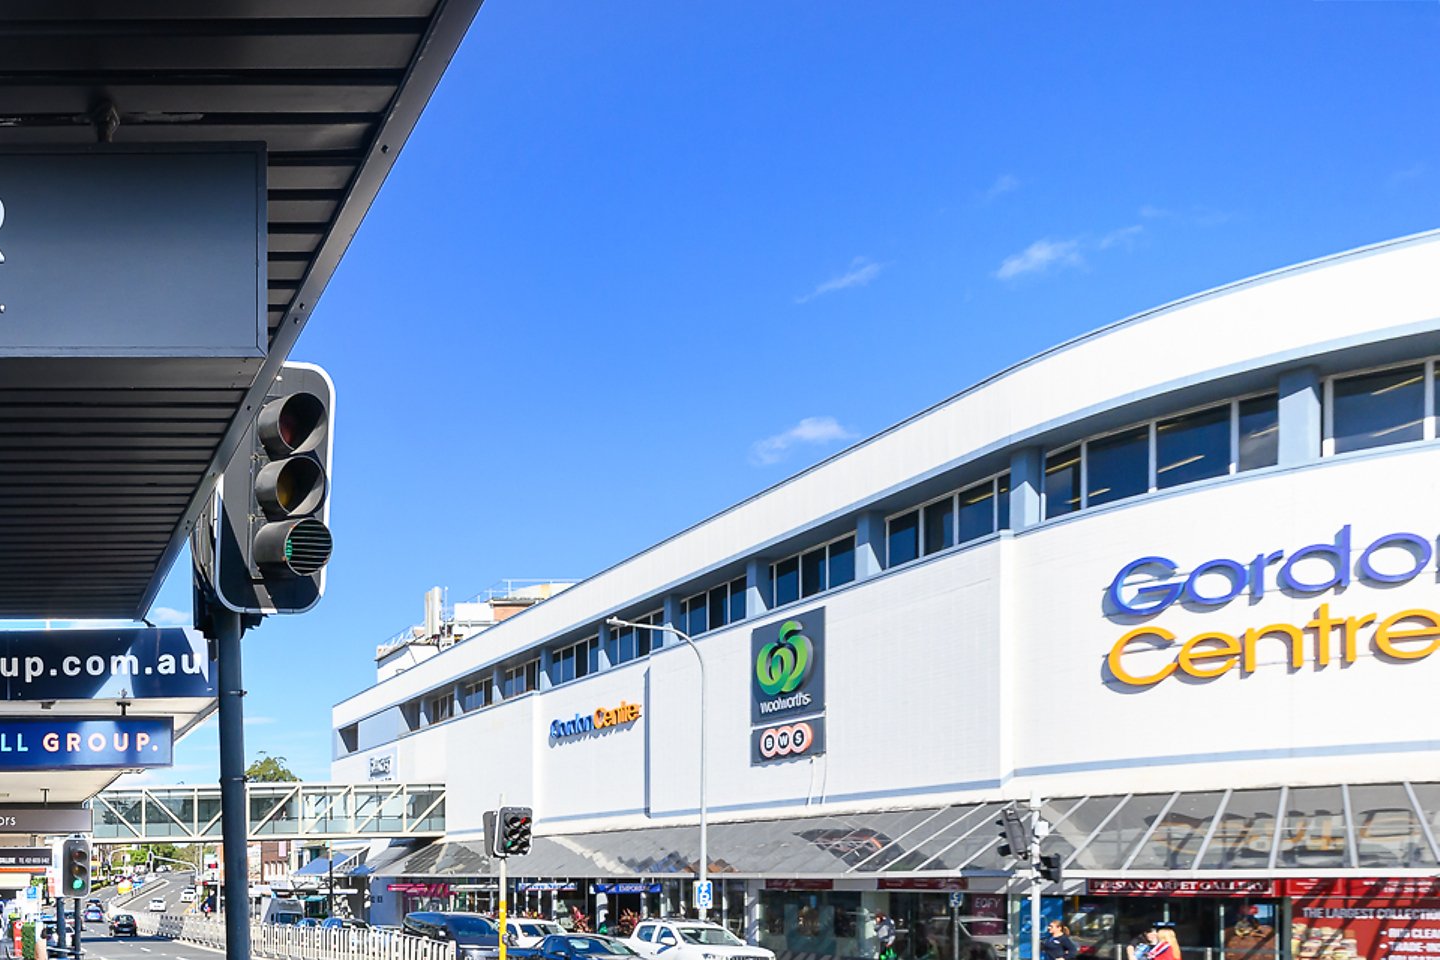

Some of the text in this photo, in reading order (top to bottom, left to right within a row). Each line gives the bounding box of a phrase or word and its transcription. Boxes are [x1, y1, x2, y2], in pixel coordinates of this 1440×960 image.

[1112, 524, 1440, 616] Gordo
[1108, 603, 1440, 686] Centre
[761, 692, 811, 714] woolworths
[42, 732, 159, 753] GROUP.
[764, 728, 805, 752] BWS
[1093, 880, 1265, 891] PERSIAN CARPET GALLERY
[1303, 907, 1324, 919] THE
[1325, 907, 1375, 920] LARGEST
